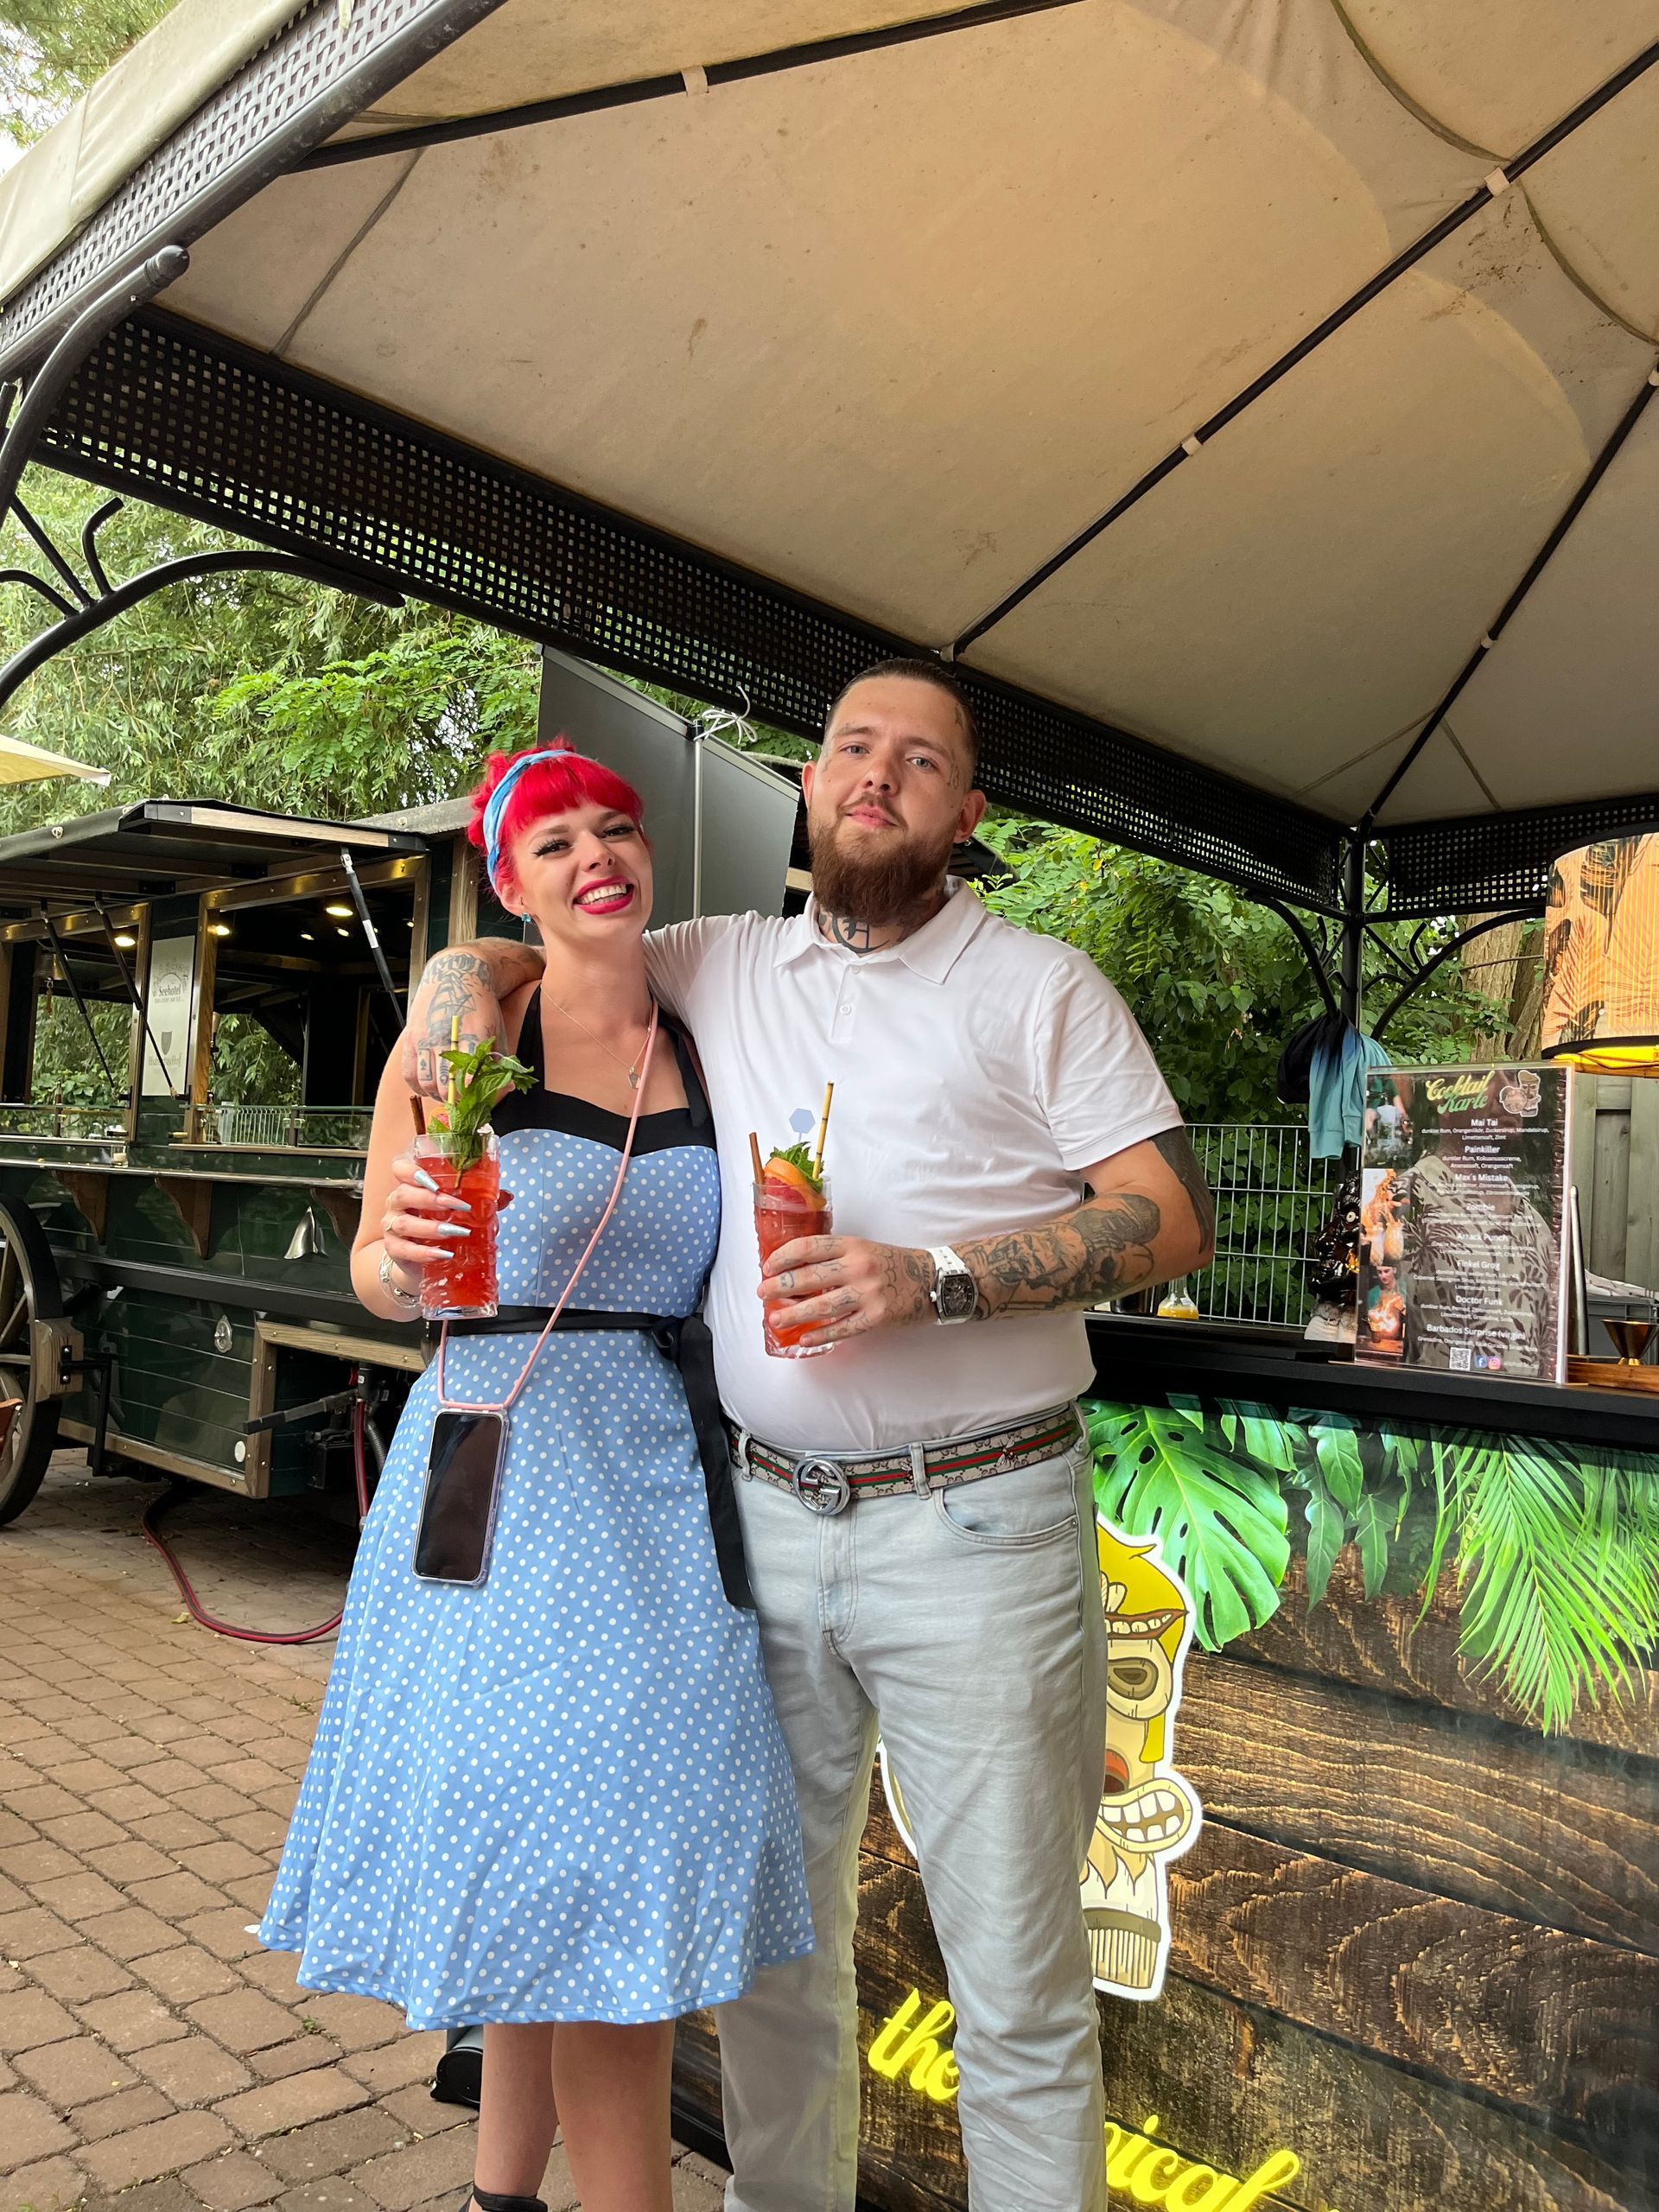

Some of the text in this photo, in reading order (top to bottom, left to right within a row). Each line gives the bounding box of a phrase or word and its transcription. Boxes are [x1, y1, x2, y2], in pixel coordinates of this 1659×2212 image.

[1426, 1071, 1495, 1101] Cocktail
[1438, 1092, 1488, 1114] Karte
[1483, 1233, 1509, 1242] Punch
[1481, 1261, 1500, 1270] Grog
[1456, 1295, 1503, 1306] Doctor Funk
[1427, 1324, 1526, 1340] Barbados Surprise (virgin)
[867, 1986, 959, 2102] the
